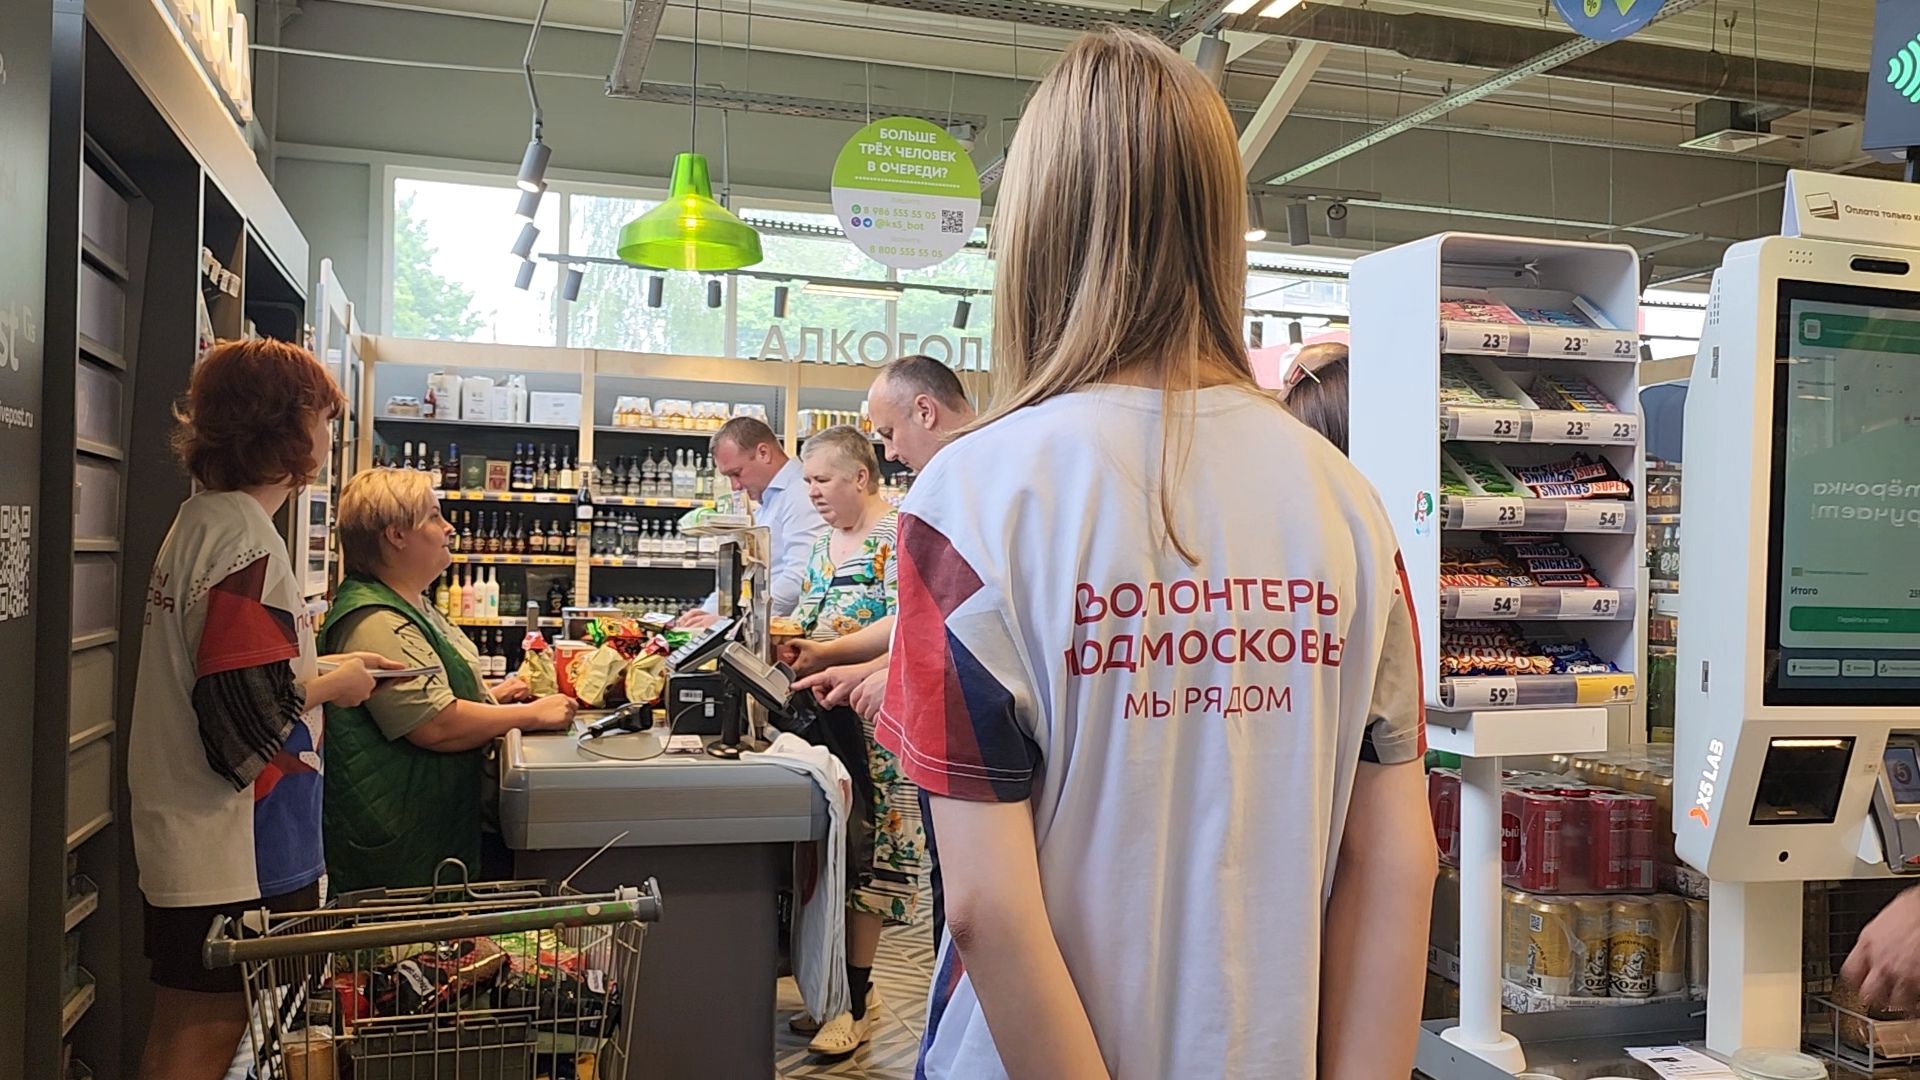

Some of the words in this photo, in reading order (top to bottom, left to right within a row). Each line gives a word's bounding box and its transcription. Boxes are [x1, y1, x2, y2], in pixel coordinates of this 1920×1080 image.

[879, 127, 937, 144] БОЛЬШЕ
[859, 142, 892, 157] ТРЁХ
[895, 147, 957, 163] ЧЕЛОВЕК
[867, 161, 875, 172] В
[879, 162, 948, 179] ОЧЕРЕДИ?
[893, 208, 908, 217] 555
[911, 210, 921, 219] 55
[1845, 205, 1879, 216] Оплата
[1881, 211, 1912, 220] только
[1482, 334, 1500, 348] 23
[1564, 337, 1581, 351] 23
[1614, 340, 1631, 354] 23
[1493, 420, 1511, 434] 23
[1566, 421, 1583, 436] 23
[1613, 423, 1630, 437] 23
[1499, 506, 1516, 521] 23
[1599, 512, 1617, 526] 54
[1531, 559, 1582, 570] SNICKERS
[1790, 587, 1818, 596] Итого
[1493, 597, 1511, 612] 54
[1592, 599, 1610, 613] 43
[1124, 690, 1177, 719] МЫ
[1184, 686, 1292, 719] РЯДОМ
[1489, 688, 1508, 703] 59
[1703, 739, 1724, 782] LAB
[1696, 780, 1714, 811] X5
